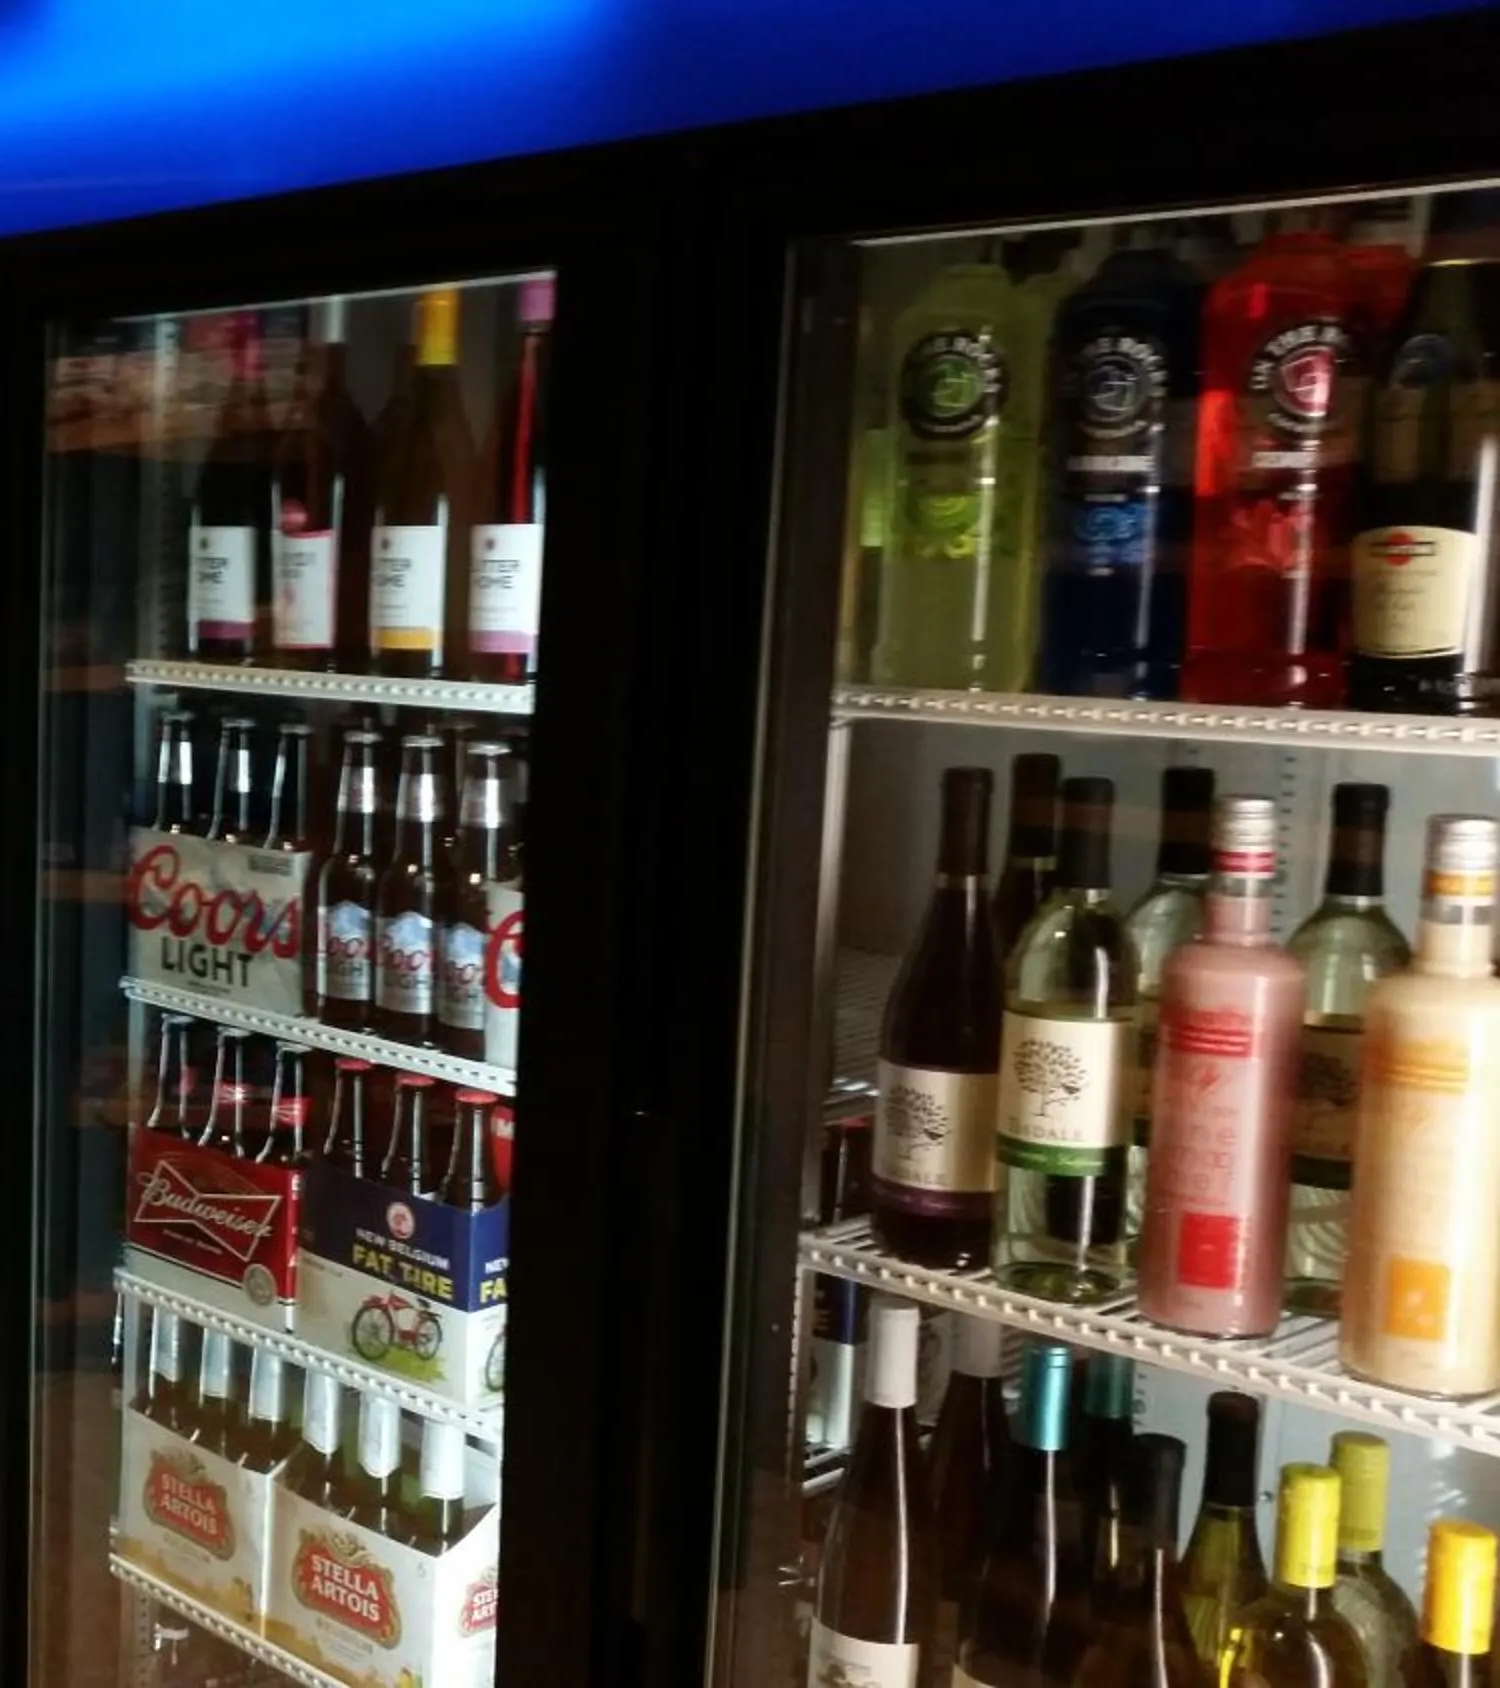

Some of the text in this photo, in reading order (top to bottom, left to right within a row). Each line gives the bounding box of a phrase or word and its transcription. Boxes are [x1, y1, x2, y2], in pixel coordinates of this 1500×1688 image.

[125, 845, 301, 988] Coors LIGHT
[137, 1172, 274, 1238] Budweiser
[355, 1228, 450, 1271] NEW BELGIUM
[353, 1243, 393, 1272] FAT
[399, 1260, 453, 1301] TIRE
[480, 1277, 508, 1304] FA
[159, 1493, 218, 1536] ARTOIS
[161, 1473, 217, 1516] STELLA
[311, 1554, 380, 1601] STELLA
[311, 1574, 381, 1622] ARTOIS
[472, 1589, 498, 1608] STE
[471, 1602, 497, 1621] ART
